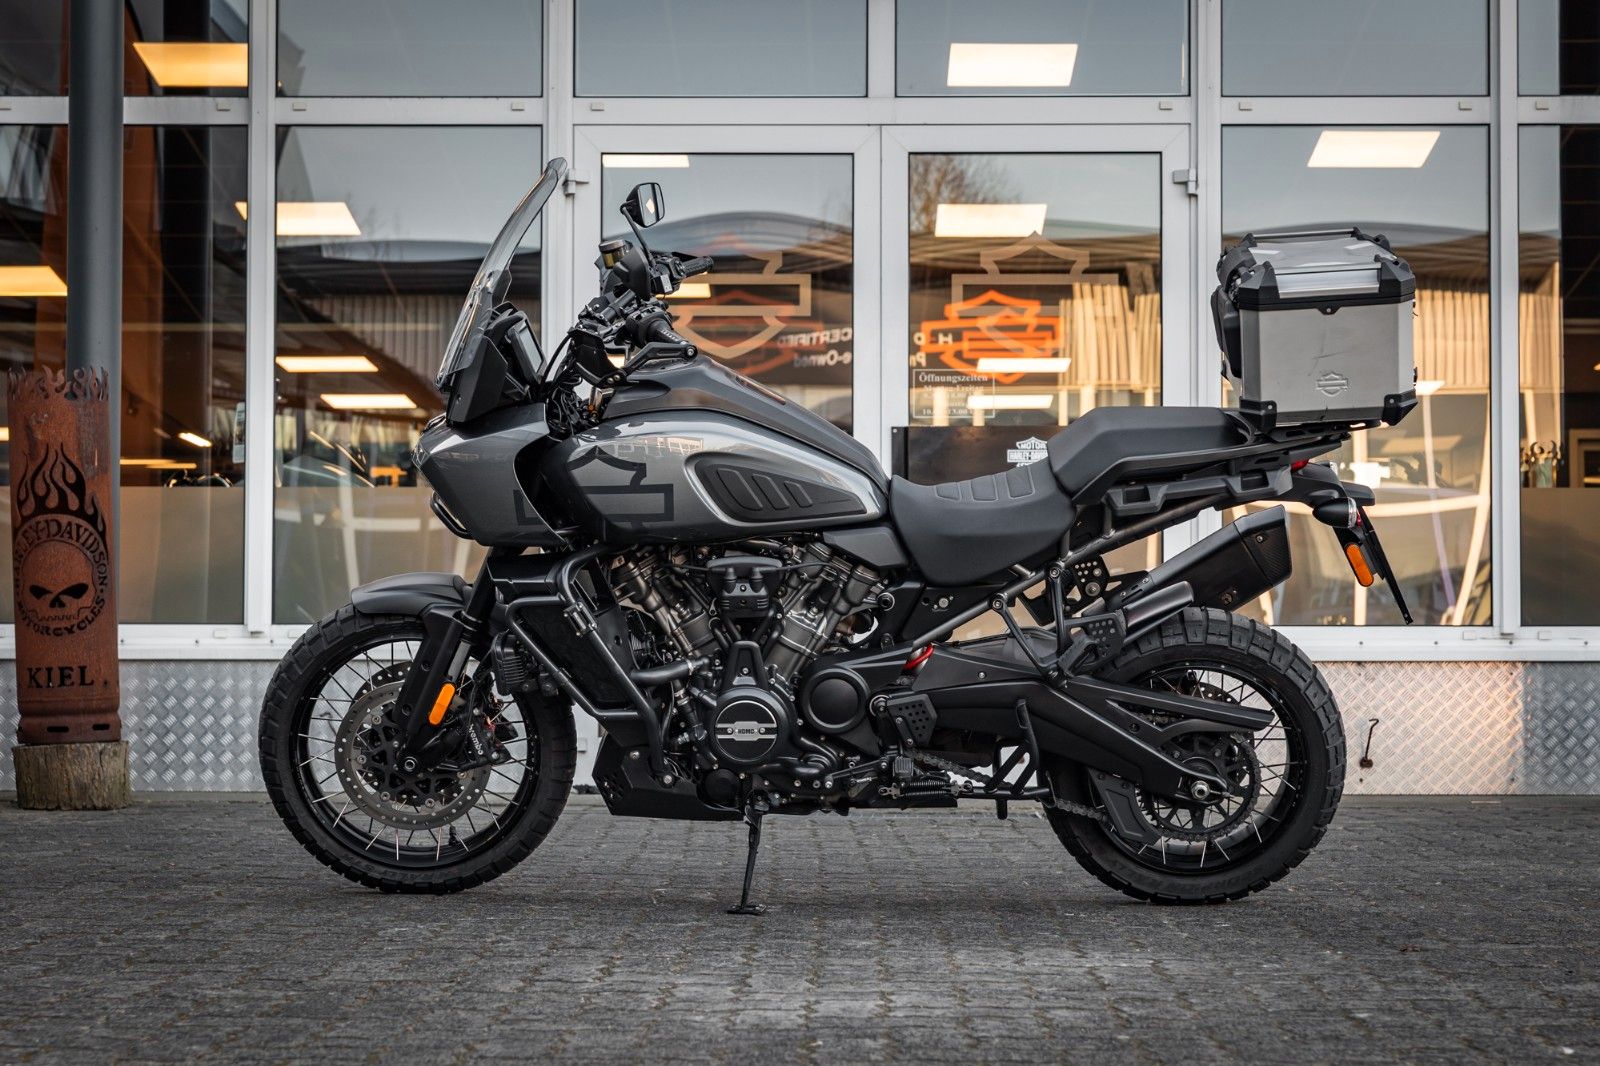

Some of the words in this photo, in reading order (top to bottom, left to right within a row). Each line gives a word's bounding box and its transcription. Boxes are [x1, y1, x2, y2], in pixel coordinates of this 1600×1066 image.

[919, 372, 988, 383] Öffnungszeiten
[1020, 441, 1047, 449] MOTOR
[27, 664, 95, 689] KIEL
